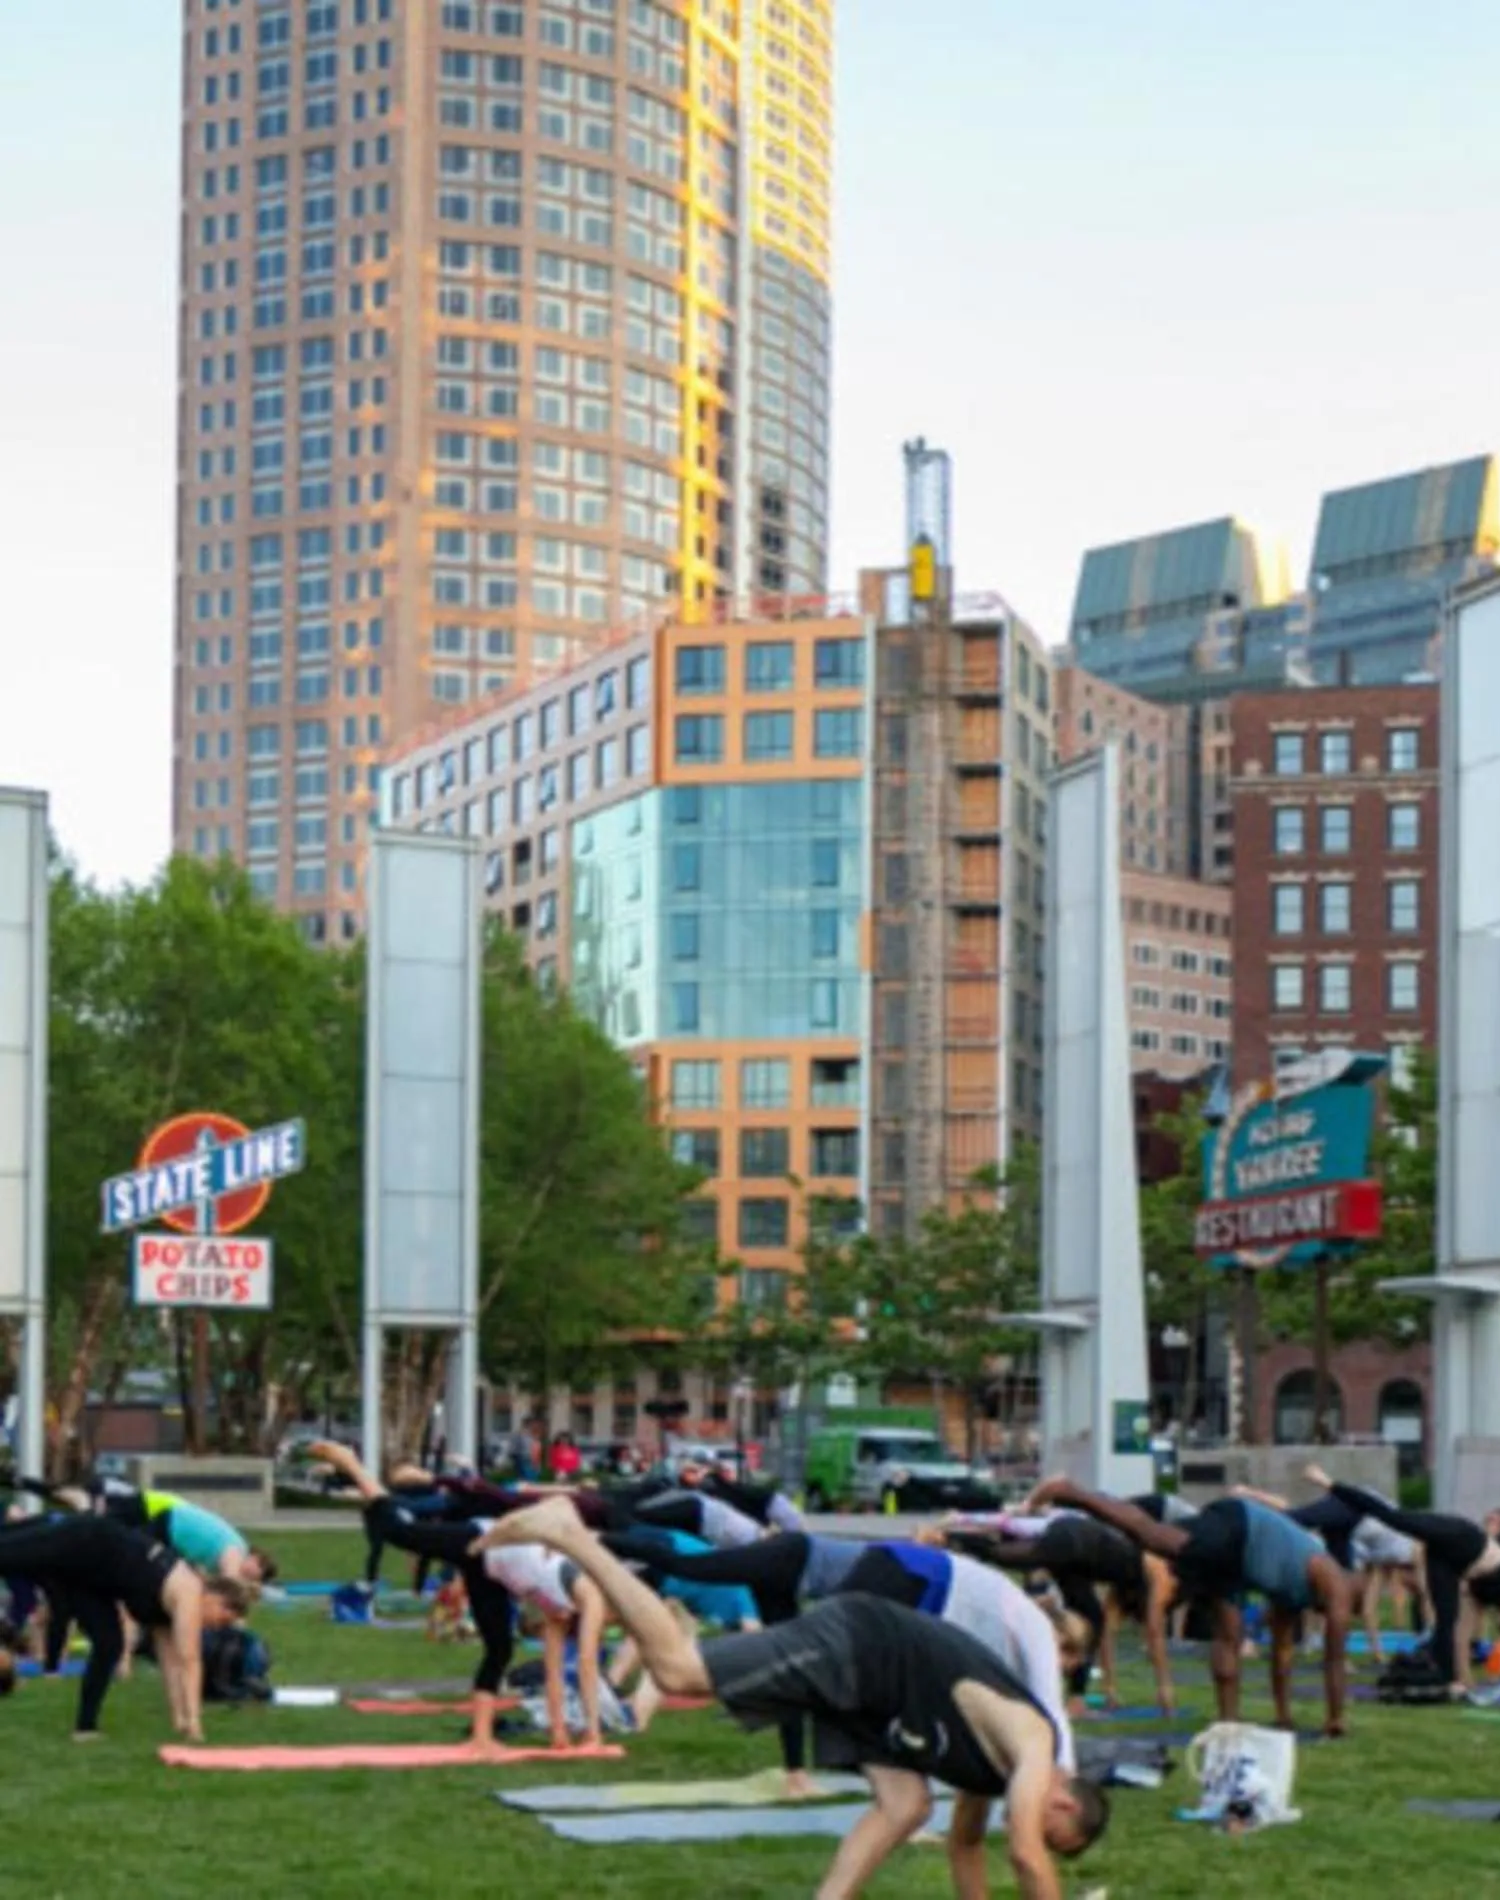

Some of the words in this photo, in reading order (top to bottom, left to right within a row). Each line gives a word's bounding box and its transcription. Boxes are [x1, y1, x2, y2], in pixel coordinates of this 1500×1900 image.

[113, 1156, 213, 1221] STATE
[224, 1128, 296, 1188] LINE
[140, 1240, 263, 1270] POTATO
[156, 1273, 251, 1304] CHIPS
